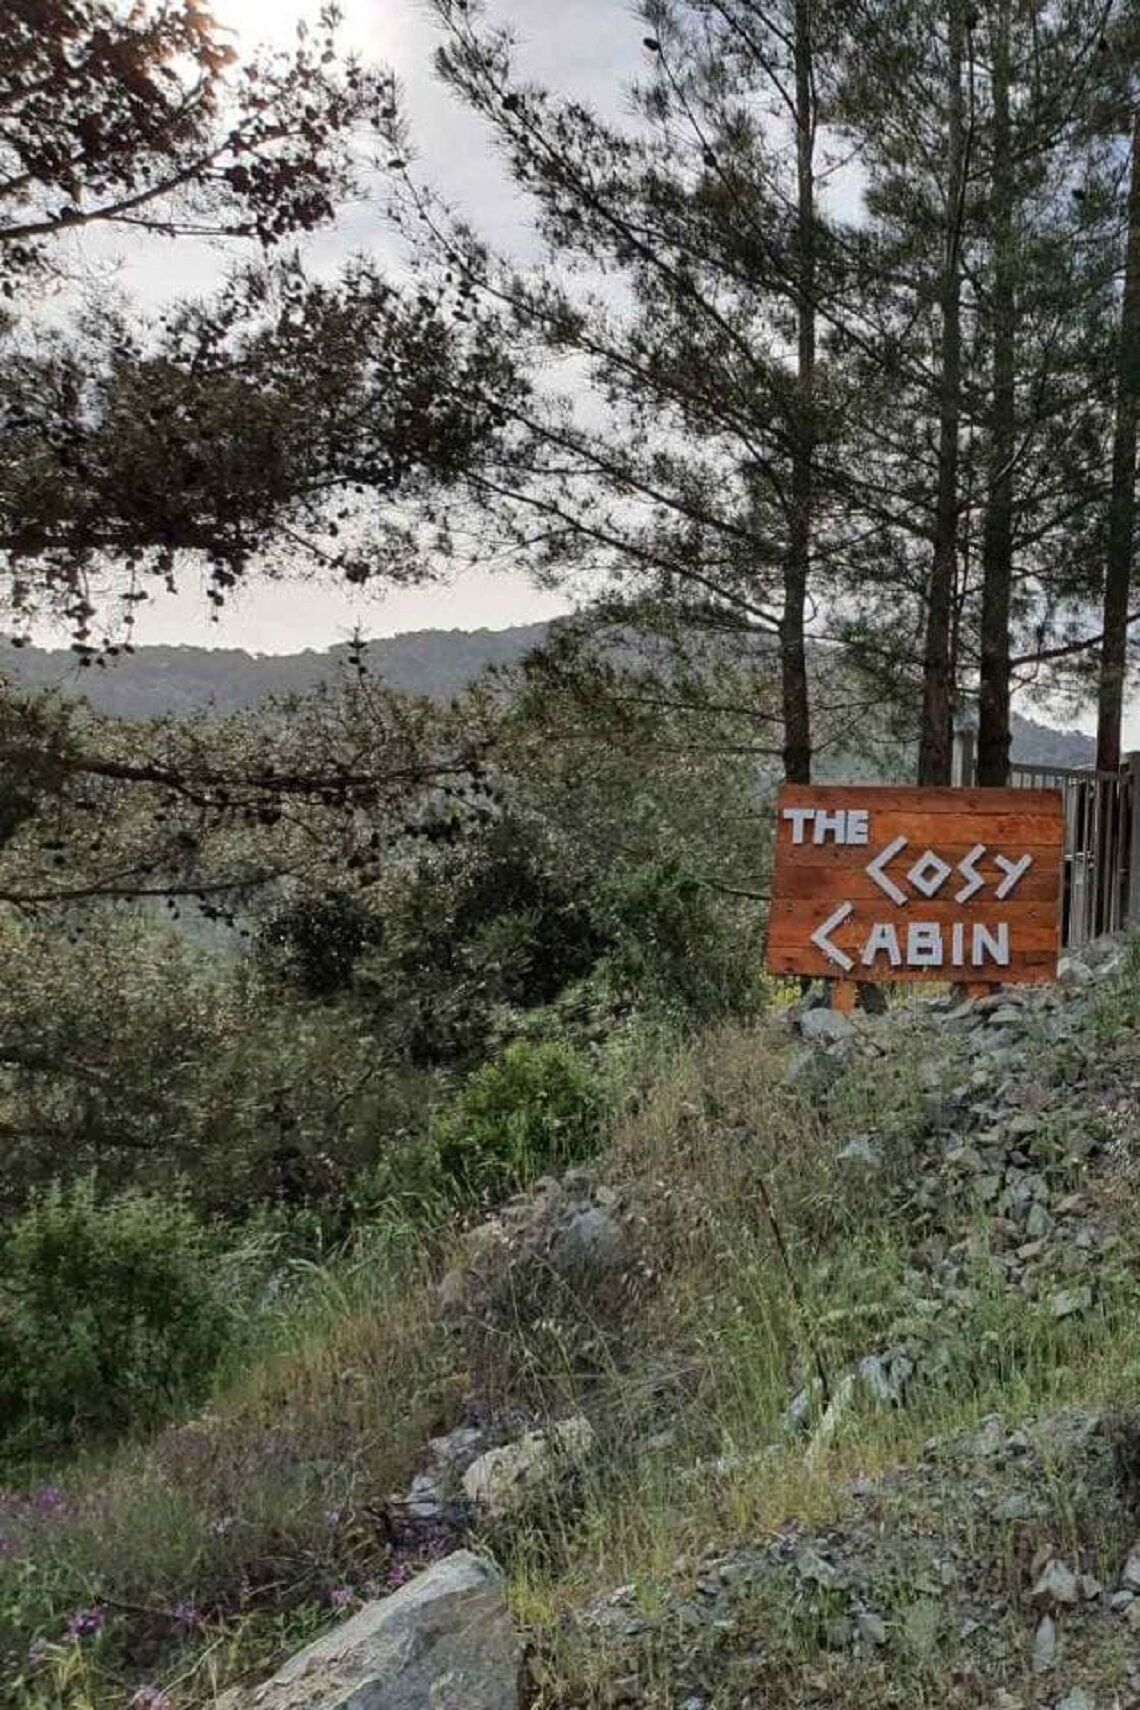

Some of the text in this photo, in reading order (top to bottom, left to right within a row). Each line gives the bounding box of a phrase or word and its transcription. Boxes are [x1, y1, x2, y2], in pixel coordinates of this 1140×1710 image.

[783, 808, 869, 844] THE
[865, 835, 1034, 906] COSY
[809, 901, 1010, 971] CABIN
